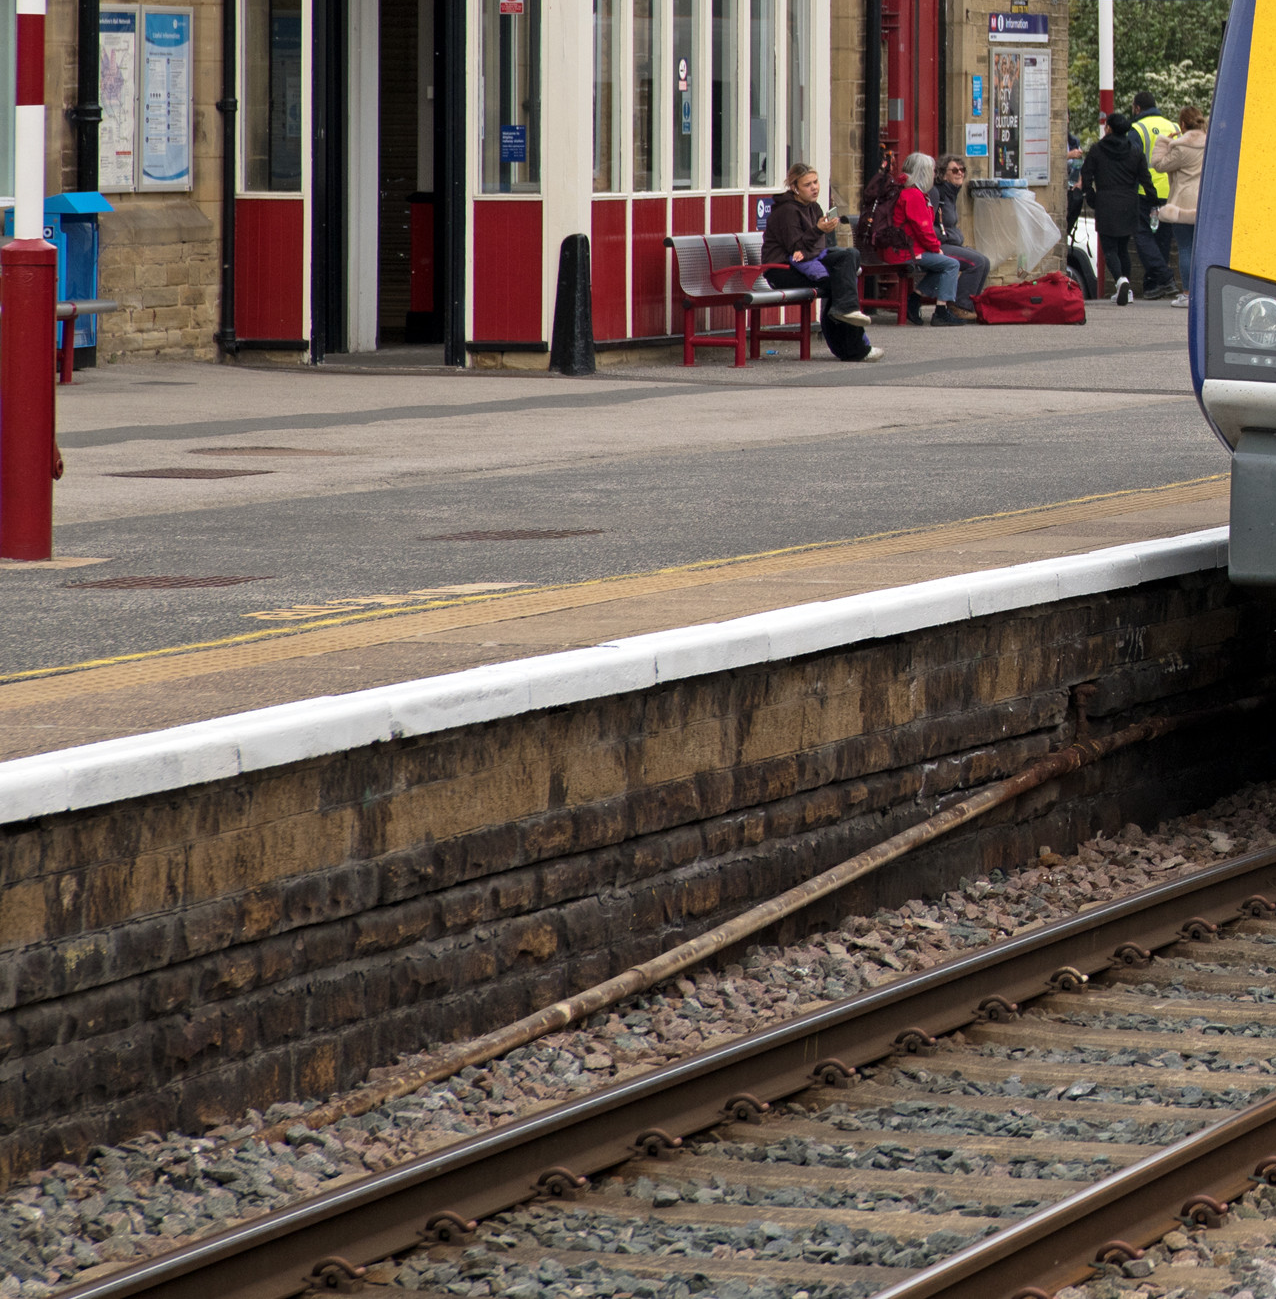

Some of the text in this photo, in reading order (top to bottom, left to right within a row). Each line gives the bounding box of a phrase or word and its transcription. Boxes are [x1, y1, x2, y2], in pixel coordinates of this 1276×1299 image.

[1005, 17, 1029, 29] Information
[1000, 88, 1012, 100] CITY
[1001, 102, 1009, 114] OF
[995, 116, 1018, 128] CULTURE
[1001, 130, 1011, 142] BID
